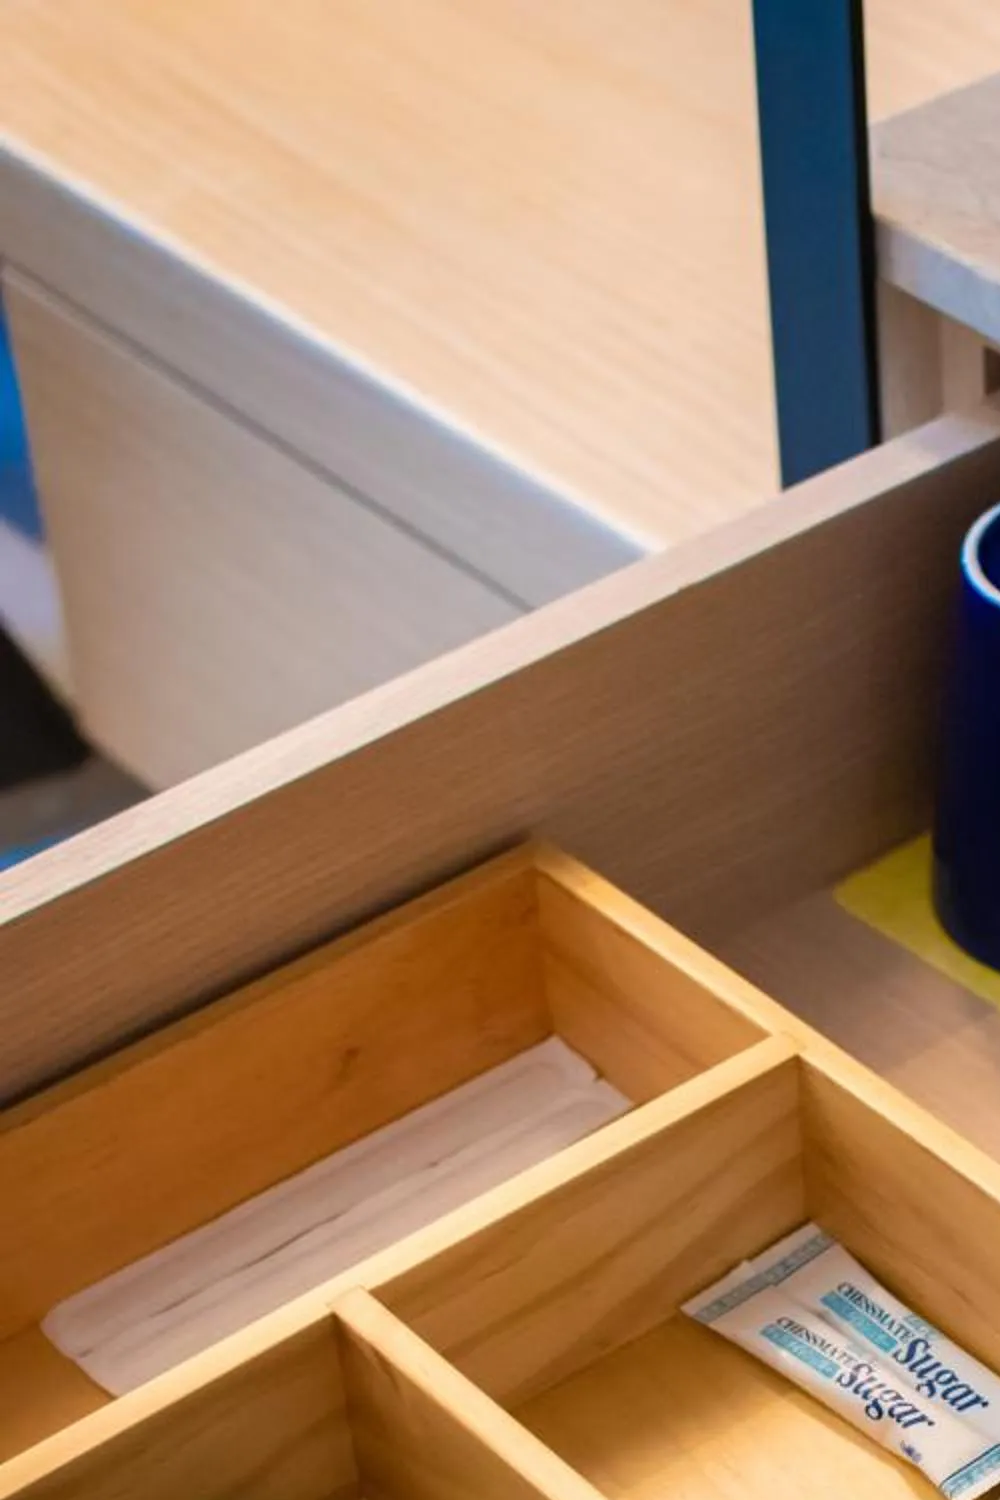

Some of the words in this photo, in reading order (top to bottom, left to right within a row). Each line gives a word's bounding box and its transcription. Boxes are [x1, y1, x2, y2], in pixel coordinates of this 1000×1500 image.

[835, 1363, 936, 1430] Sugar
[837, 1281, 913, 1344] CHESSMATE
[892, 1337, 989, 1413] Sugar
